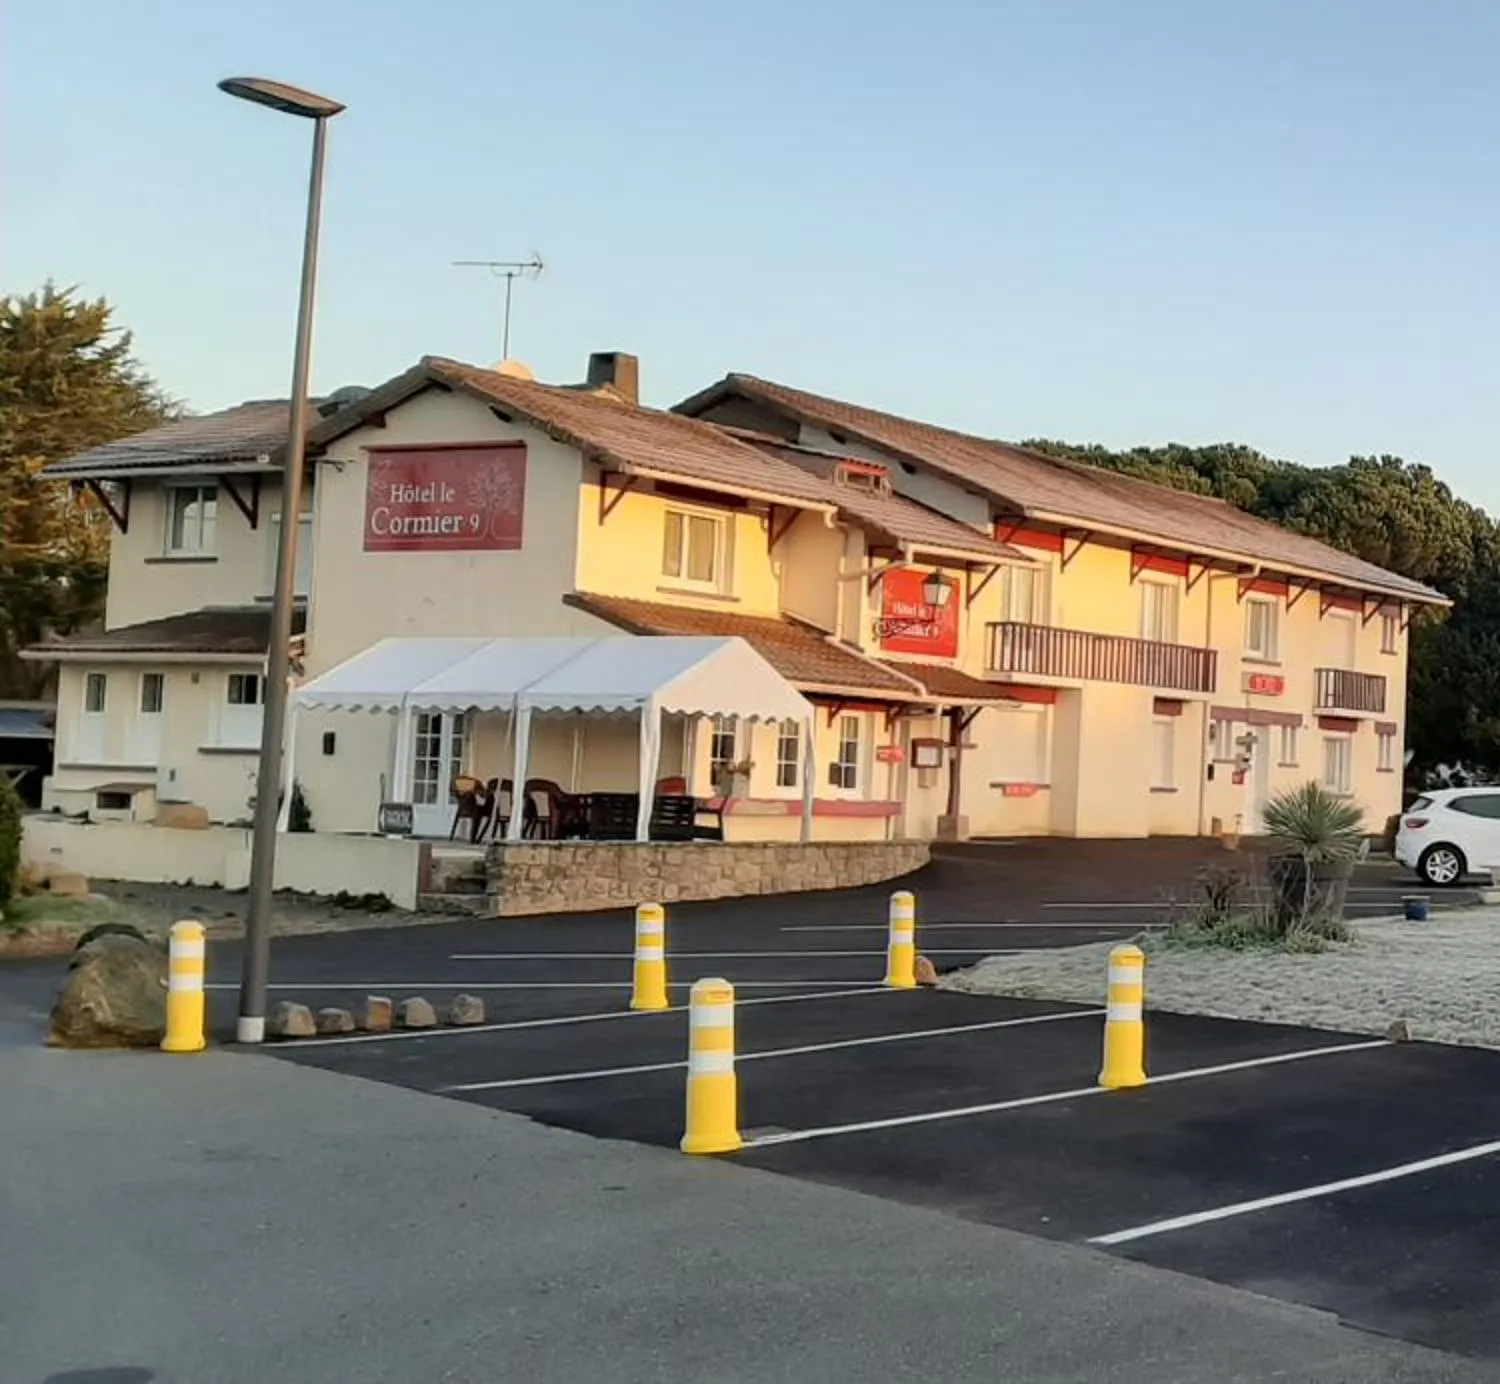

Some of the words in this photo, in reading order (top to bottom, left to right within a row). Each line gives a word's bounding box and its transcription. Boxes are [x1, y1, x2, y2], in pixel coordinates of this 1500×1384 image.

[390, 481, 435, 504] Hôtel
[440, 481, 456, 502] le
[371, 506, 463, 535] Cormier
[469, 512, 480, 532] 9
